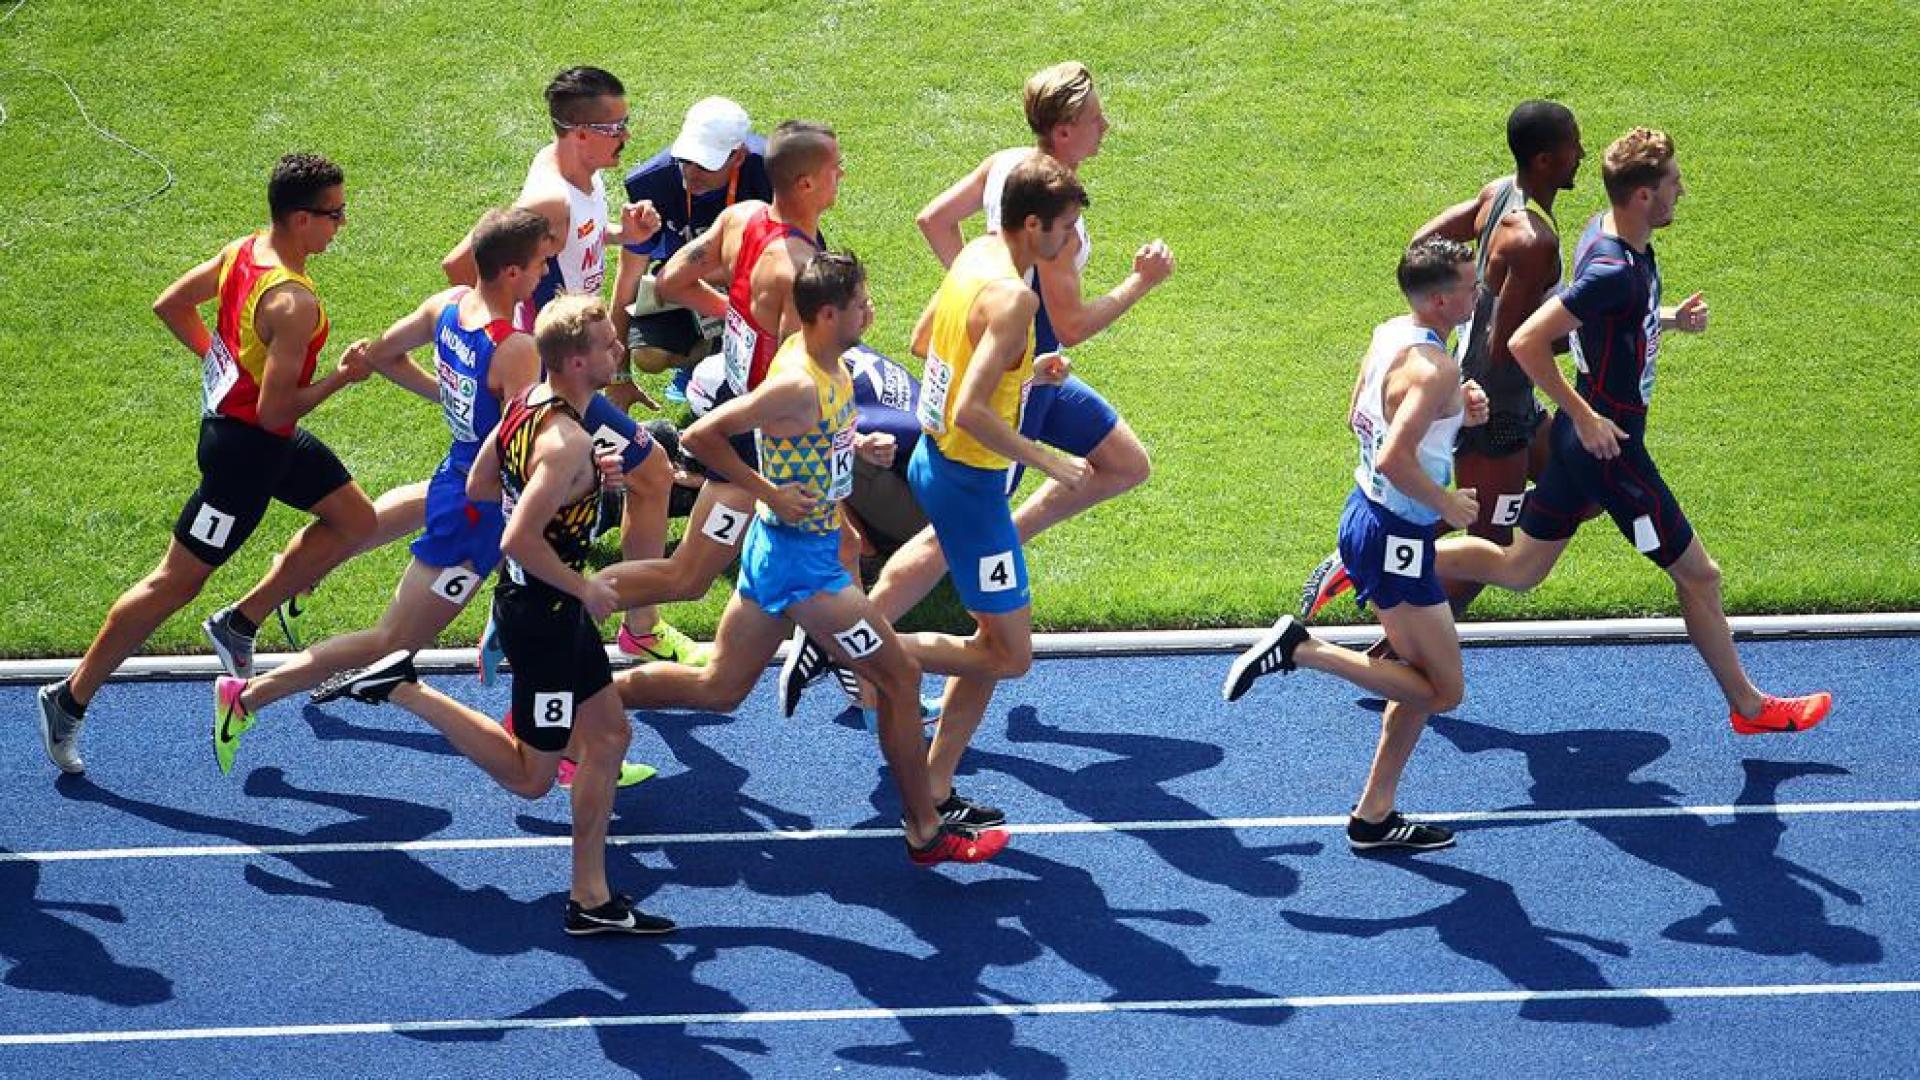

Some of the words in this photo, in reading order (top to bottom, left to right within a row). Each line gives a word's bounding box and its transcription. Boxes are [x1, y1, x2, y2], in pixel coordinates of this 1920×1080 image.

[207, 514, 221, 532] 1
[1504, 499, 1521, 522] 5
[713, 513, 736, 539] 2
[1395, 544, 1415, 571] 9
[443, 575, 466, 597] 6
[990, 561, 1009, 586] 4
[841, 628, 878, 654] 12
[544, 698, 563, 723] 8
